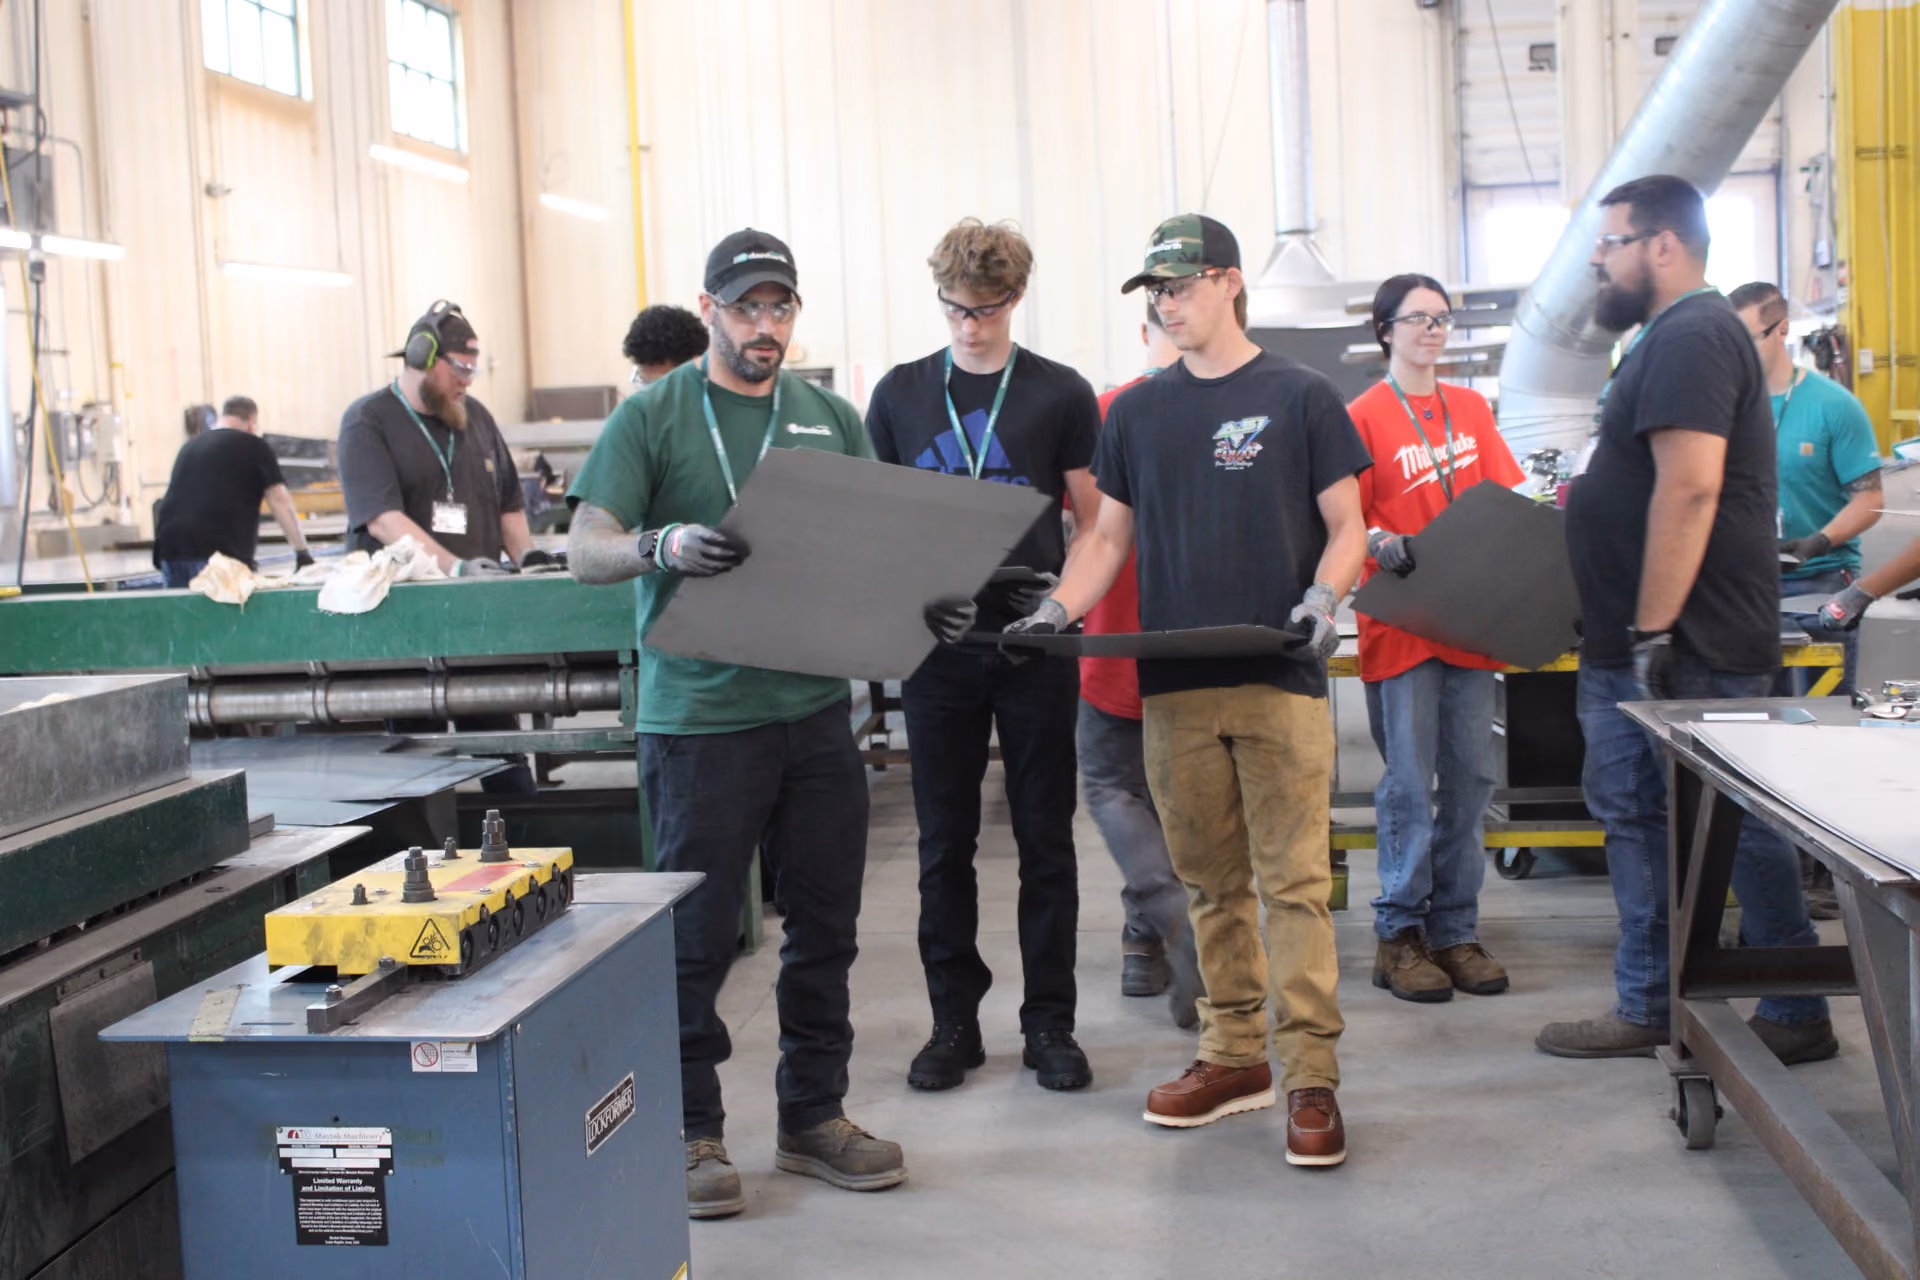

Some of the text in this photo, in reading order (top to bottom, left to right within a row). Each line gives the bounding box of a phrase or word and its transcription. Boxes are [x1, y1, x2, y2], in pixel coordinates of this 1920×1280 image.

[588, 1087, 633, 1143] LOCKFORMER
[336, 1177, 363, 1186] Warranty
[352, 1185, 376, 1193] Liability
